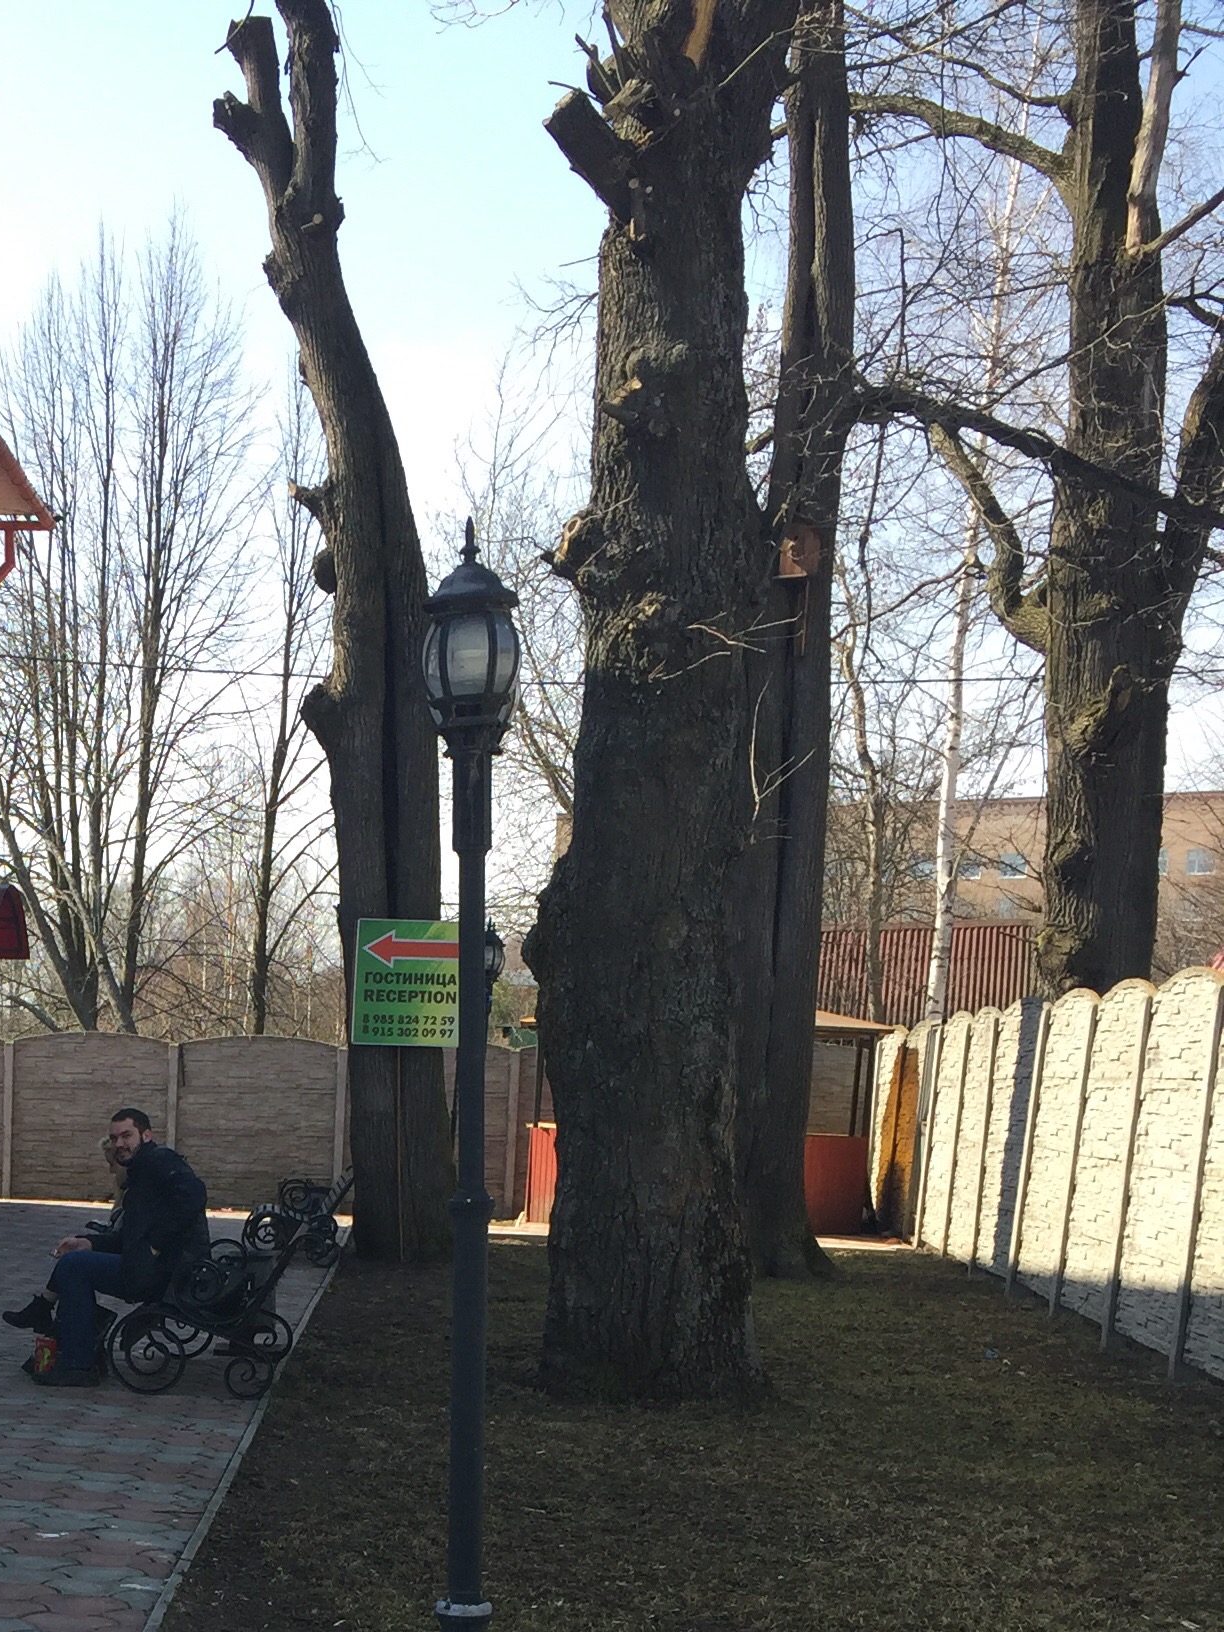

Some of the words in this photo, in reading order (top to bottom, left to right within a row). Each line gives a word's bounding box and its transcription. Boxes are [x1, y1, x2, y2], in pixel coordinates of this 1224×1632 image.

[364, 971, 457, 988] ГОСТИНИЦА
[363, 989, 457, 1004] RECEPTION
[362, 1014, 370, 1024] 8
[372, 1014, 394, 1025] 985
[397, 1015, 419, 1025] 824
[422, 1015, 437, 1026] 72
[440, 1016, 455, 1026] 59
[362, 1024, 369, 1034] 8
[372, 1027, 393, 1037] 915
[397, 1027, 419, 1037] 302
[422, 1028, 437, 1038] 09
[440, 1028, 454, 1039] 97
